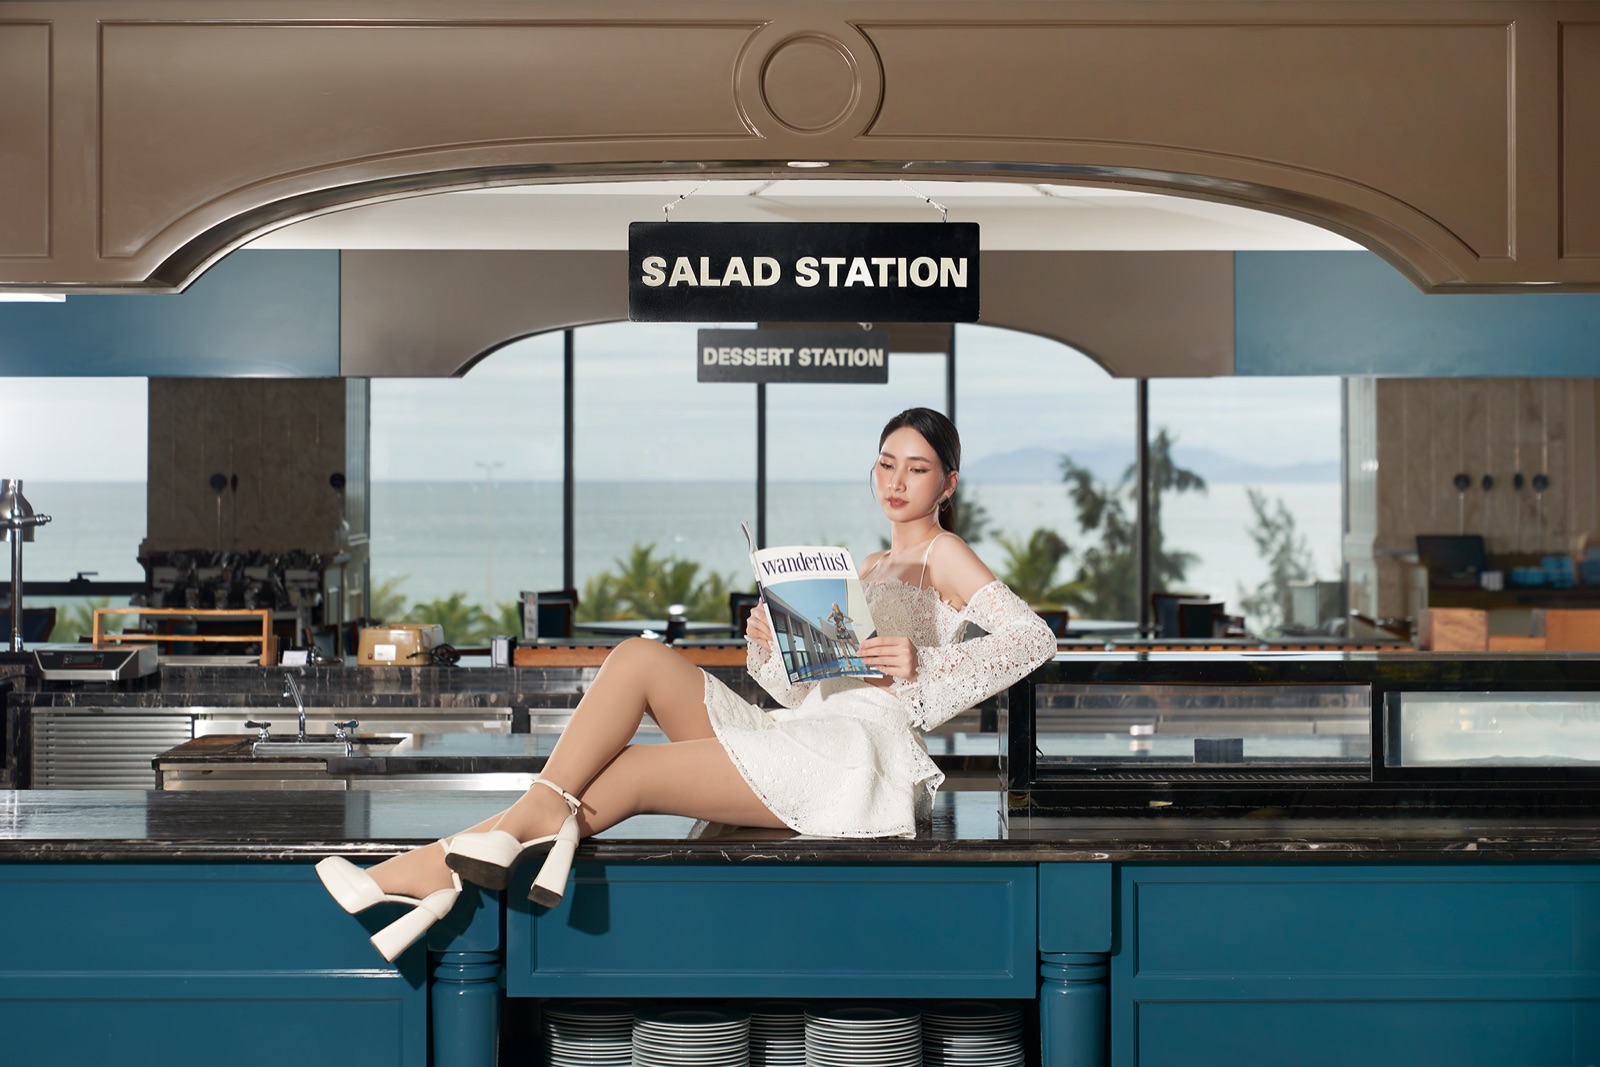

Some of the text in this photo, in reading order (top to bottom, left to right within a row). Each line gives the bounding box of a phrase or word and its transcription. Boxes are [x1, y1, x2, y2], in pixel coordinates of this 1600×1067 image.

[641, 255, 968, 288] SALAD STATION
[702, 346, 884, 367] DESSERT STATION
[761, 552, 850, 576] wanderlust
